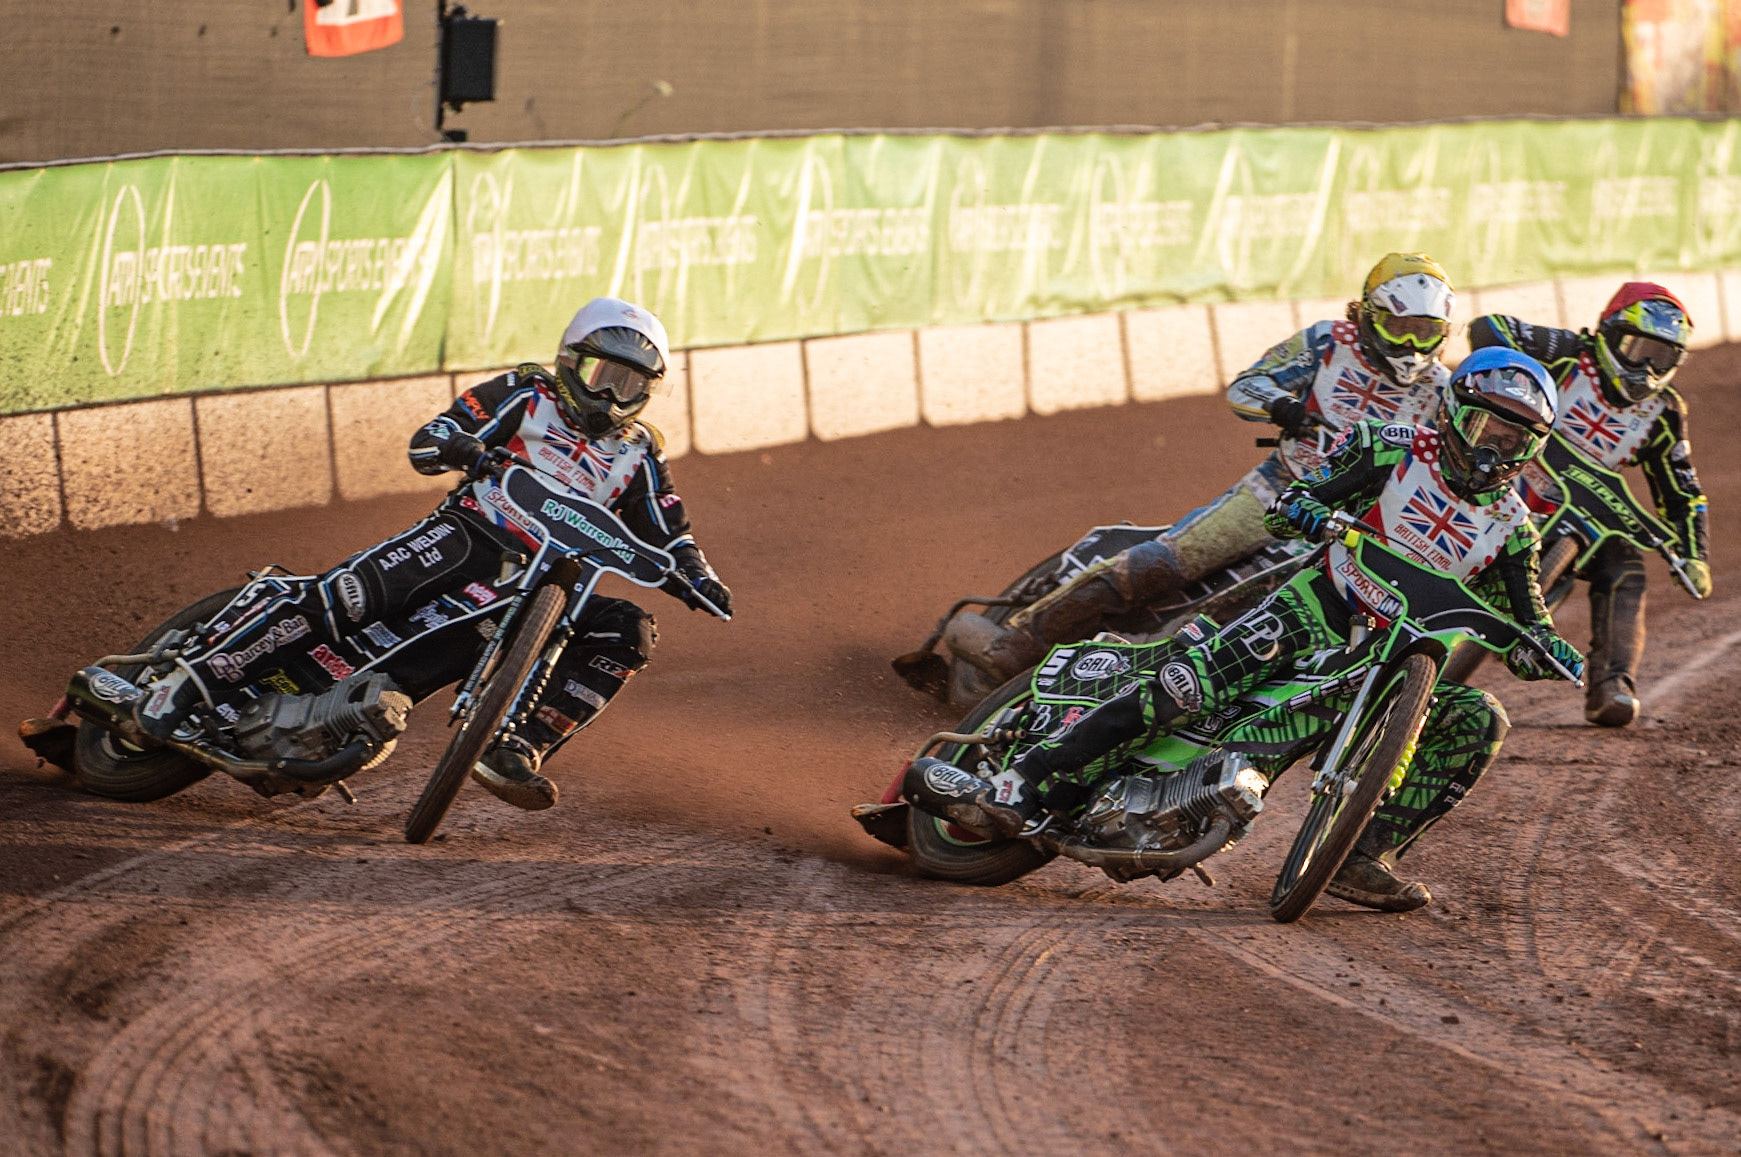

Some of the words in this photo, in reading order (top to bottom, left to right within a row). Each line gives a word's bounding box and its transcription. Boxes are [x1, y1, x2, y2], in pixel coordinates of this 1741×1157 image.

[564, 506, 613, 548] Warren
[1393, 523, 1432, 553] BRITISH
[1426, 549, 1453, 571] FINAL
[418, 546, 444, 568] Ltd
[1341, 562, 1386, 606] SPORTS
